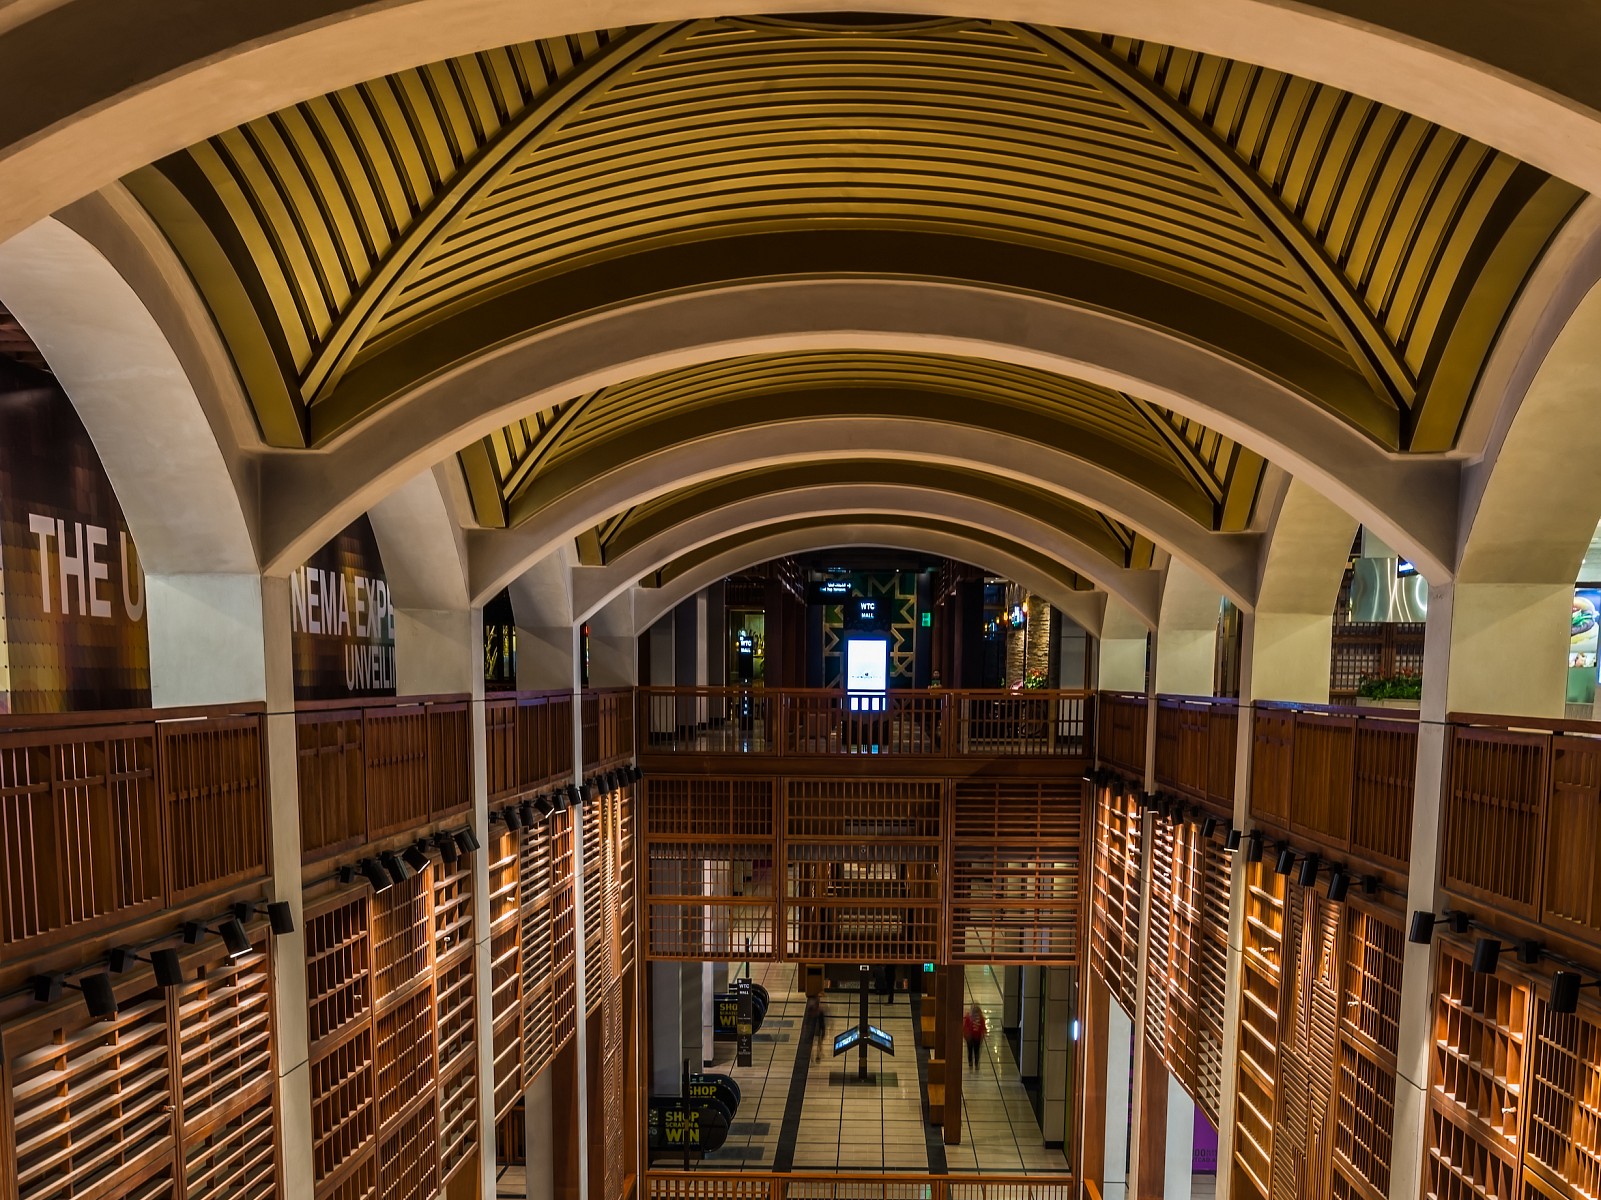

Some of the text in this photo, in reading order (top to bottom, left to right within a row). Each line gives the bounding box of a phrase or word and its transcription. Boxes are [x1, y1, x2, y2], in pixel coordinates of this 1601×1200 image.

[28, 513, 112, 618] THE
[290, 565, 395, 639] NEMA EXPE
[860, 602, 875, 610] WTC
[345, 644, 396, 691] UNVEILI
[719, 1003, 738, 1011] SHO
[719, 1015, 738, 1026] WI
[665, 1111, 700, 1122] SHP
